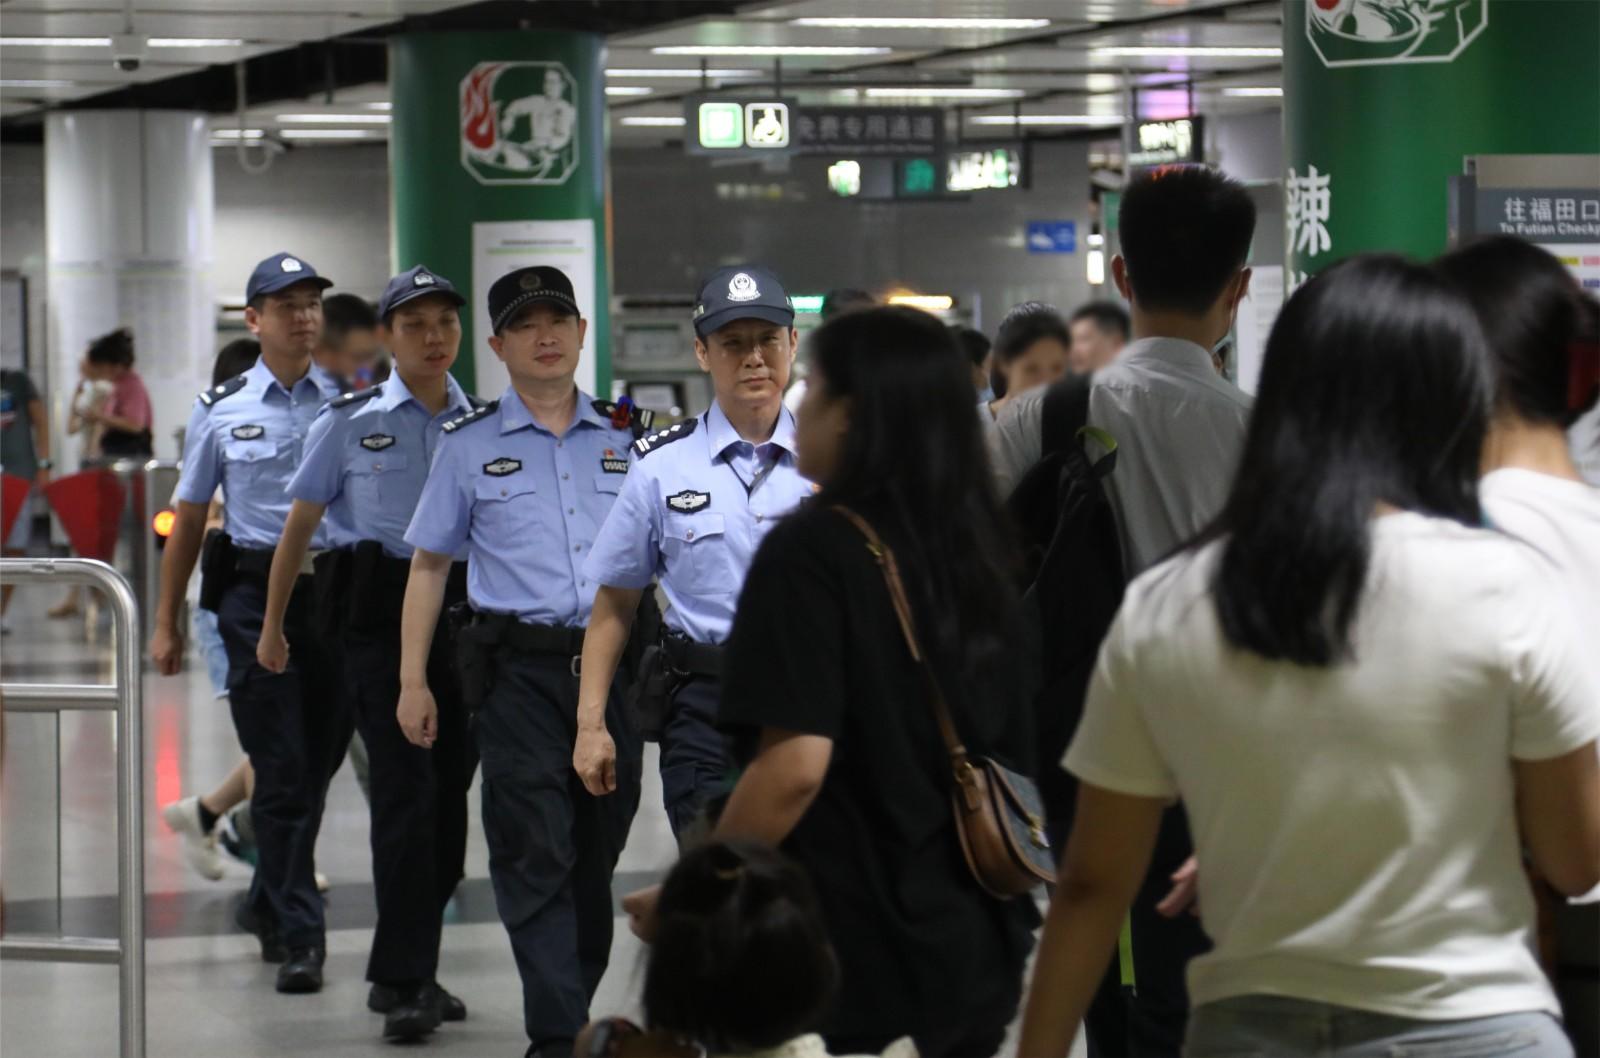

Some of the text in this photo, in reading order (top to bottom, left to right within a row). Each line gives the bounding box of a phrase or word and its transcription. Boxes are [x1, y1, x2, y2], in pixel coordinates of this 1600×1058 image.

[1503, 197, 1599, 222] 往福田口
[1287, 164, 1331, 298] 辣
[1499, 222, 1515, 234] To
[1516, 222, 1556, 235] Futian
